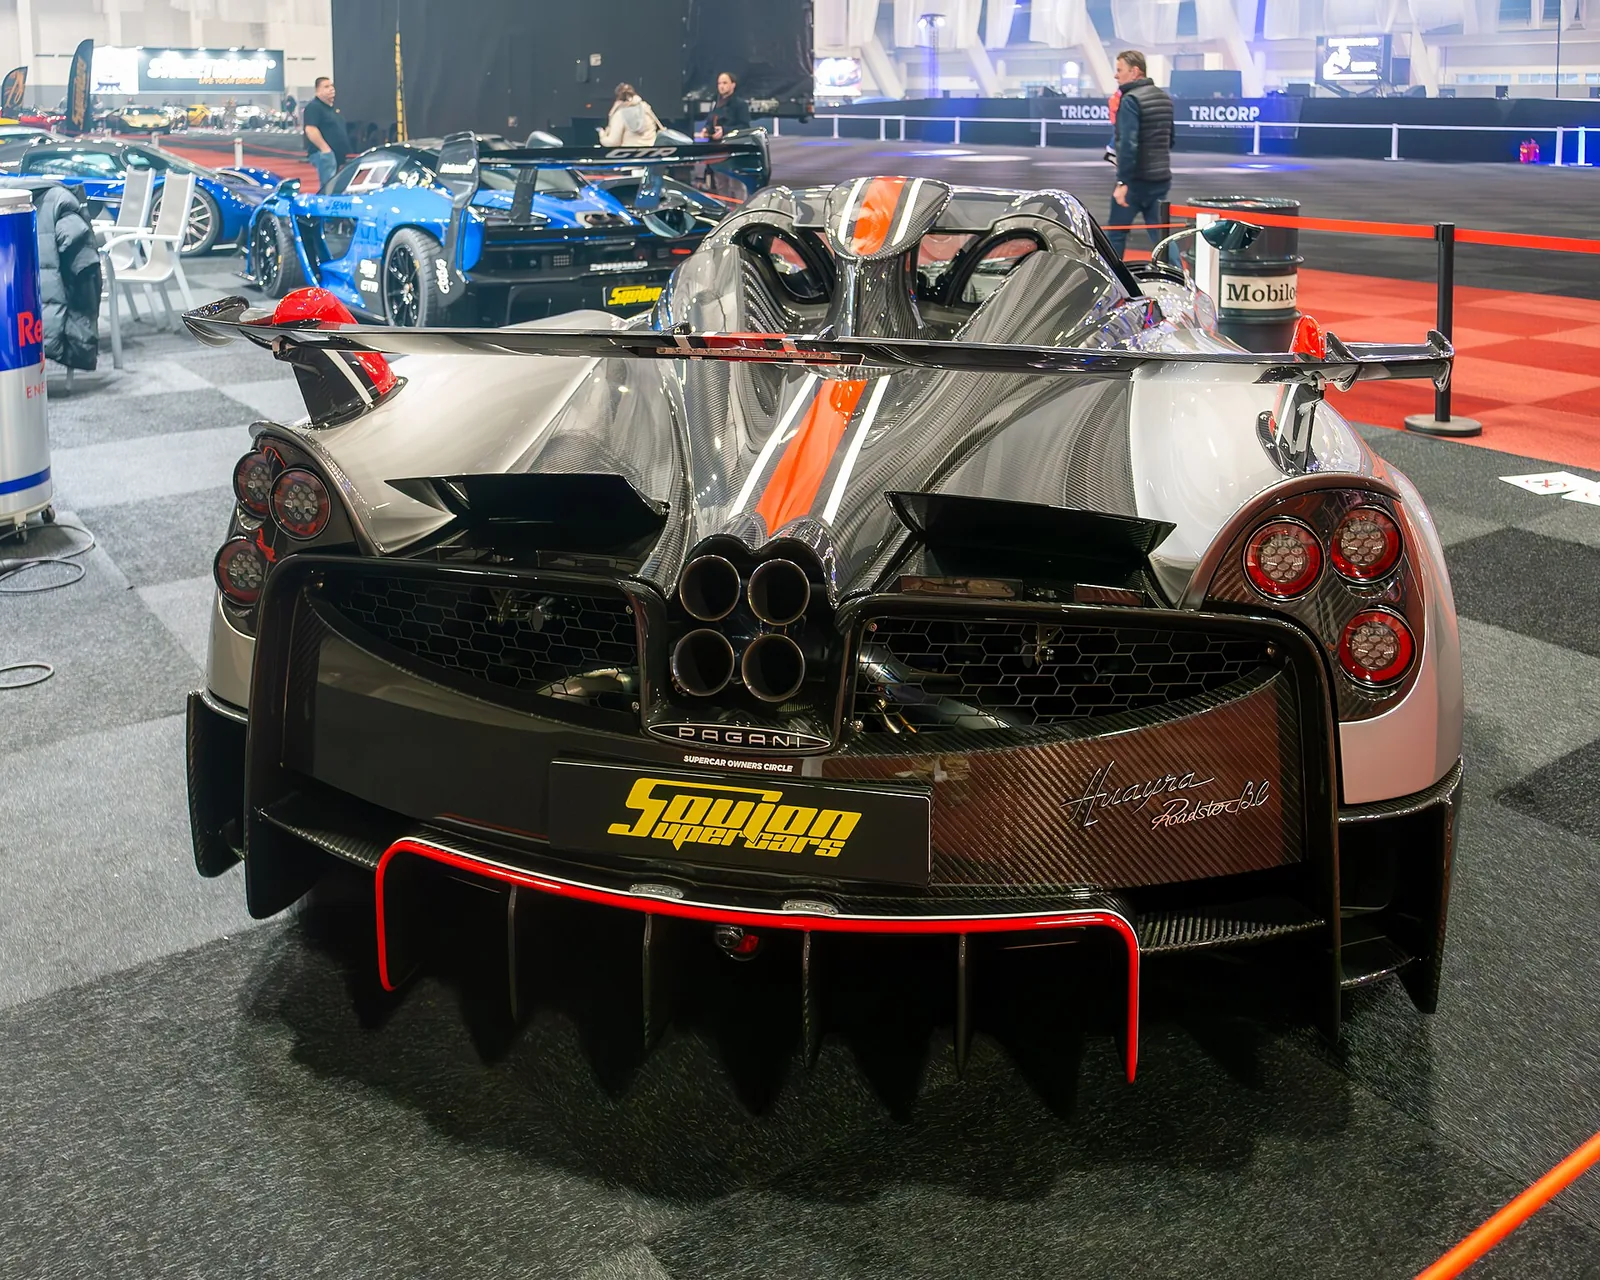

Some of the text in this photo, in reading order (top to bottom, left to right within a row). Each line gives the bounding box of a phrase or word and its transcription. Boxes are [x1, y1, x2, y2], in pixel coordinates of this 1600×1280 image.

[1060, 105, 1109, 119] TRICOR
[1189, 106, 1260, 121] TRICORP
[605, 147, 677, 158] GTR
[1227, 283, 1296, 302] Mobilo
[678, 726, 800, 748] PAGANI
[683, 755, 793, 772] SUPERCAR OWNERS CIRCLE
[1060, 760, 1215, 827] Huayra
[607, 778, 862, 844] Soujon
